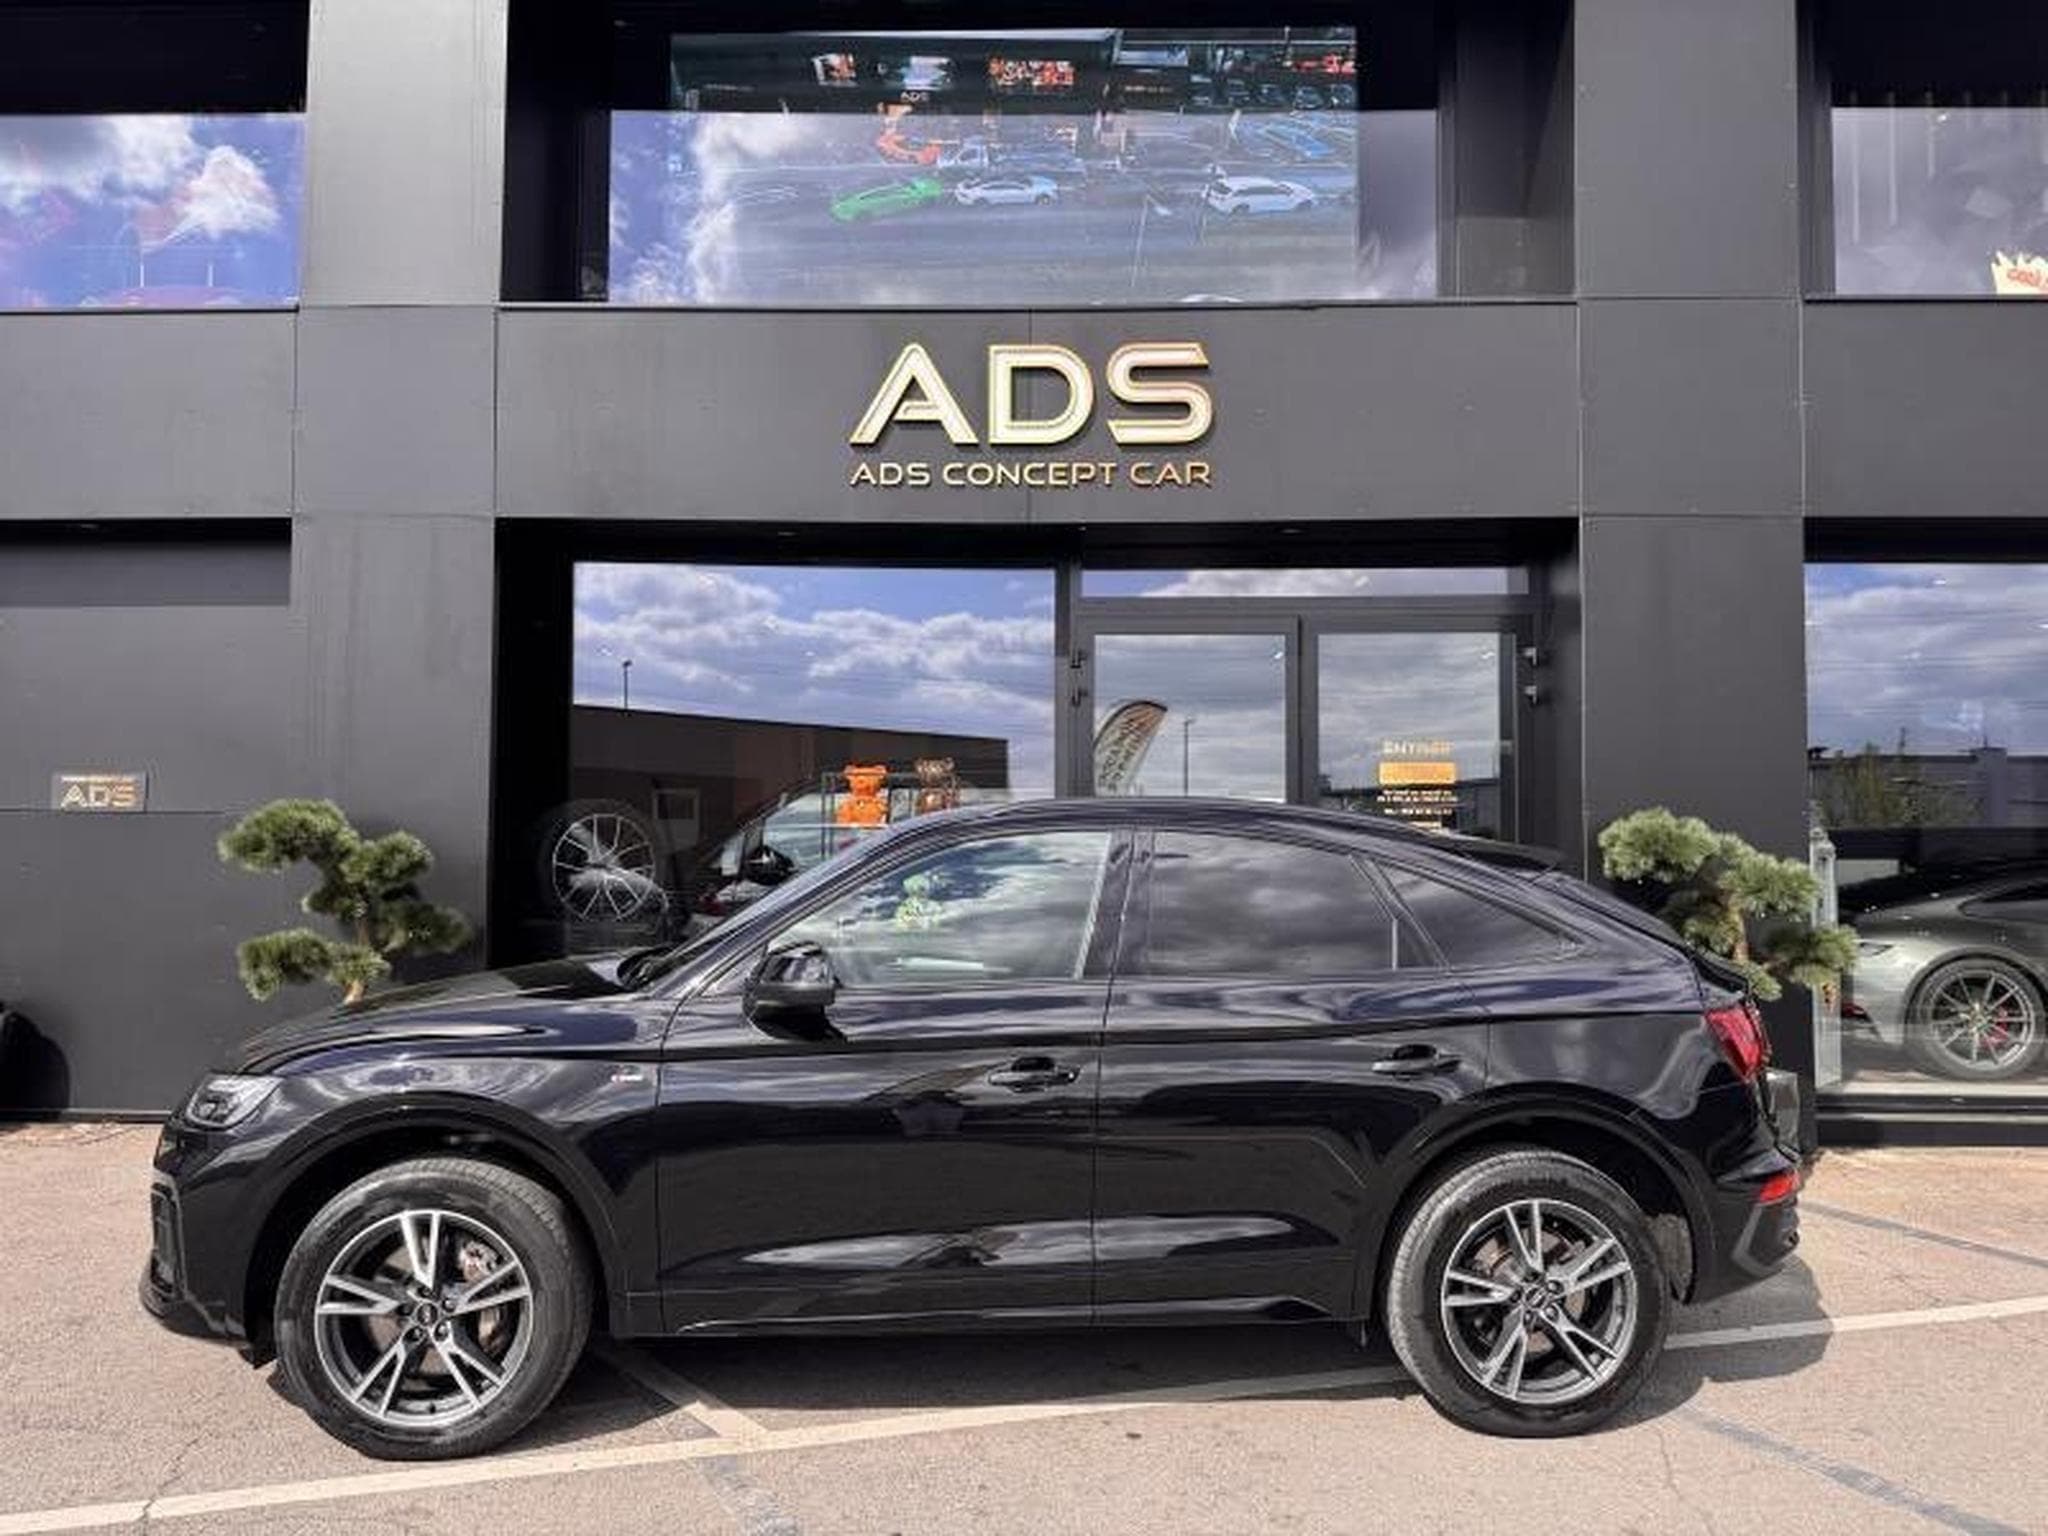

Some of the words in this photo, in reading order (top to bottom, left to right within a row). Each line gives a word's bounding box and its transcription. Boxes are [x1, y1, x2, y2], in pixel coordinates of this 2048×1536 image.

[850, 342, 1213, 445] ADS
[850, 462, 931, 486] ADS
[943, 462, 1117, 486] CONCEPT
[1130, 462, 1212, 486] CAR
[60, 784, 135, 808] ADS
